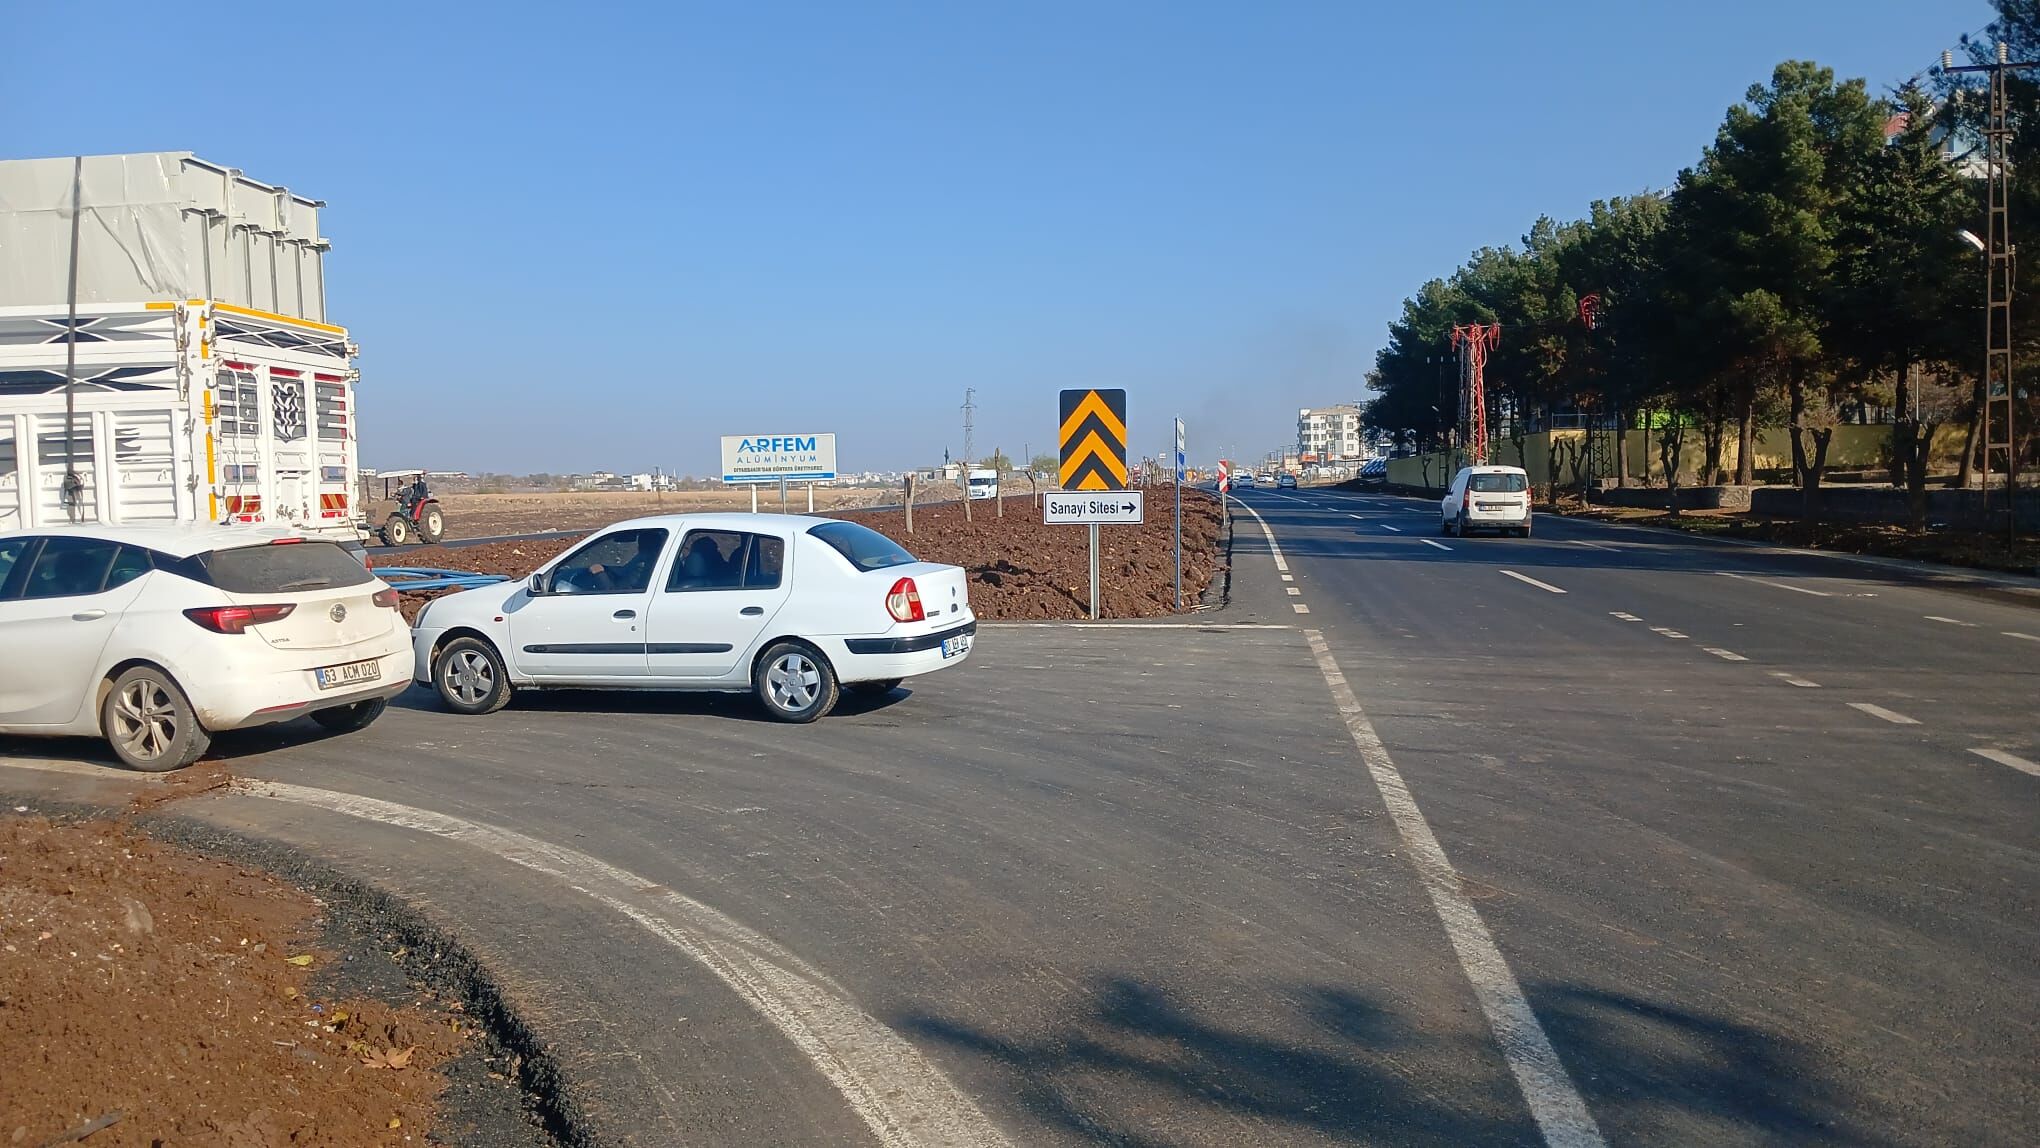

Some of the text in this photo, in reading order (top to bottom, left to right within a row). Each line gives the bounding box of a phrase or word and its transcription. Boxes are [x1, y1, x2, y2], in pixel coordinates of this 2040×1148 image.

[737, 437, 816, 453] ARFEM
[737, 454, 817, 464] ALÜMİNYUM
[1050, 501, 1119, 517] Sanayi Sitesi
[324, 662, 377, 682] 63 ACM 020
